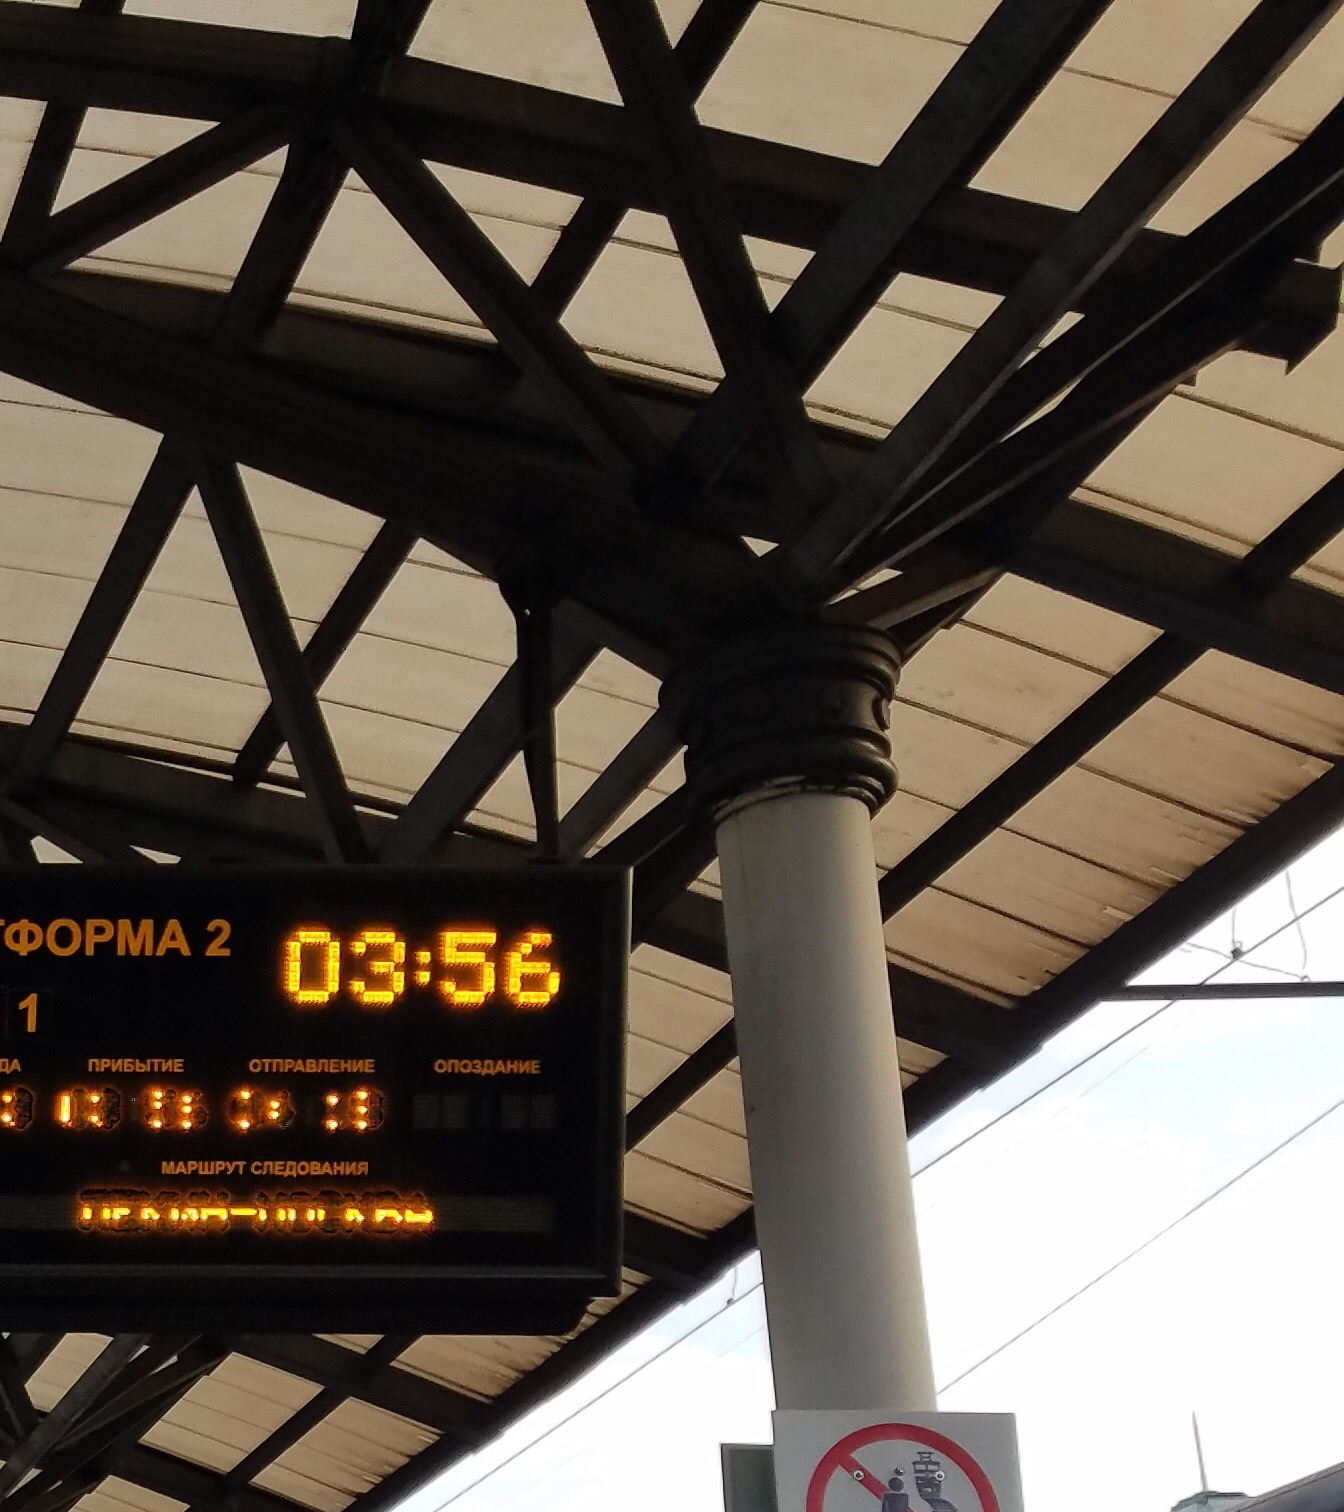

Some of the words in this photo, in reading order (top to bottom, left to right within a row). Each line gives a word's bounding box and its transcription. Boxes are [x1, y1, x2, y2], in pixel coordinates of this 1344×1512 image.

[204, 918, 232, 957] 2
[281, 925, 562, 1008] 03:56
[17, 992, 40, 1033] 1
[87, 1057, 184, 1073] ПРИБЫТИЕ
[247, 1057, 375, 1074] ОТПРАВЛЕНИЕ
[434, 1058, 541, 1075] ОПОЗДАНИЕ
[160, 1160, 246, 1176] МАРШРУТ
[249, 1160, 369, 1178] СЛЕДОВАНИЯ
